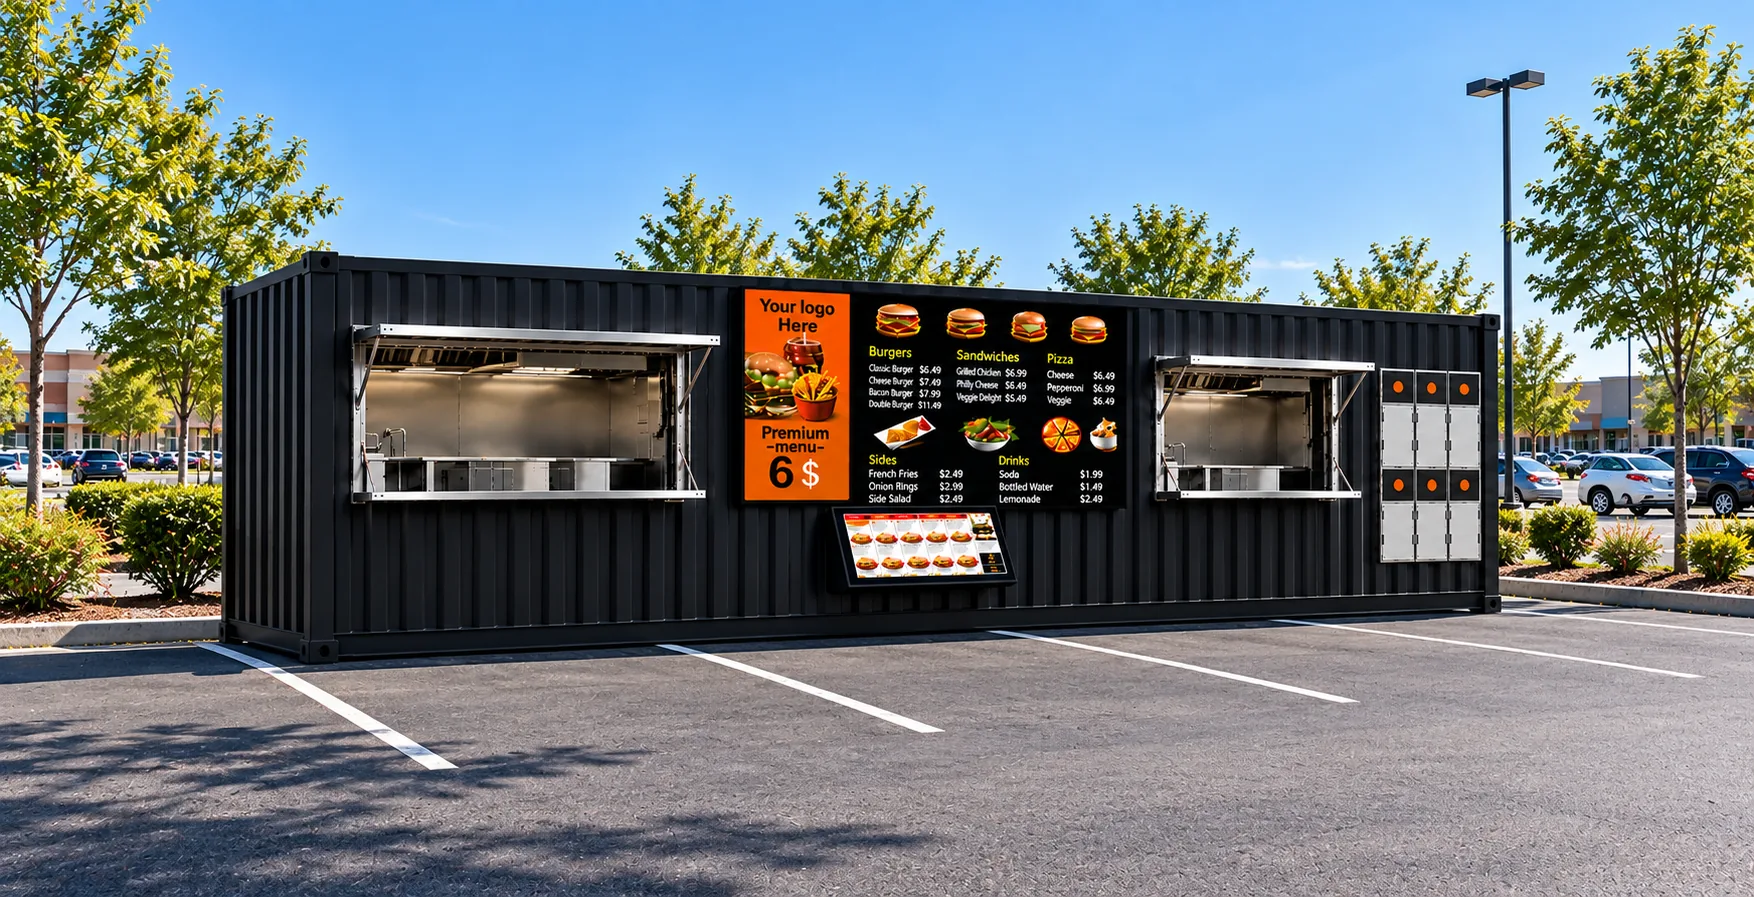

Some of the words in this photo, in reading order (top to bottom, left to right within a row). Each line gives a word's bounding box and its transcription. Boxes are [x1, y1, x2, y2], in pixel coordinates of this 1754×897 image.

[760, 298, 797, 314] Your
[800, 299, 835, 318] logo
[778, 318, 818, 333] Here
[869, 345, 912, 360] Burgers
[956, 349, 1020, 362] Sandwiches
[1047, 353, 1074, 364] Pizza
[868, 363, 891, 373] Classic
[892, 364, 914, 375] Burger
[919, 365, 942, 374] $6.49
[956, 366, 976, 376] Grilled
[1005, 368, 1027, 377] $6.99
[1046, 369, 1075, 379] Cheese
[1093, 370, 1115, 380] $6.49
[868, 375, 891, 385] Cheese
[892, 376, 914, 388] Burger
[919, 377, 942, 386] $7.49
[956, 379, 974, 391] Philly
[975, 380, 999, 389] Cheese
[1046, 382, 1084, 393] Pepperoni
[1093, 383, 1115, 393] $6.99
[868, 387, 890, 396] Bacon
[890, 388, 913, 400] Burger
[918, 389, 941, 398] $7.99
[956, 392, 978, 403] Veggie
[979, 393, 1002, 404] Delight
[1004, 393, 1027, 403] $5.49
[868, 399, 891, 408] Double
[892, 400, 914, 411] Burger
[917, 400, 942, 409] $11.49
[1046, 395, 1072, 406] Veggie
[1093, 396, 1115, 406] $6.49
[761, 425, 830, 440] Premium
[868, 454, 897, 465] Sides
[998, 455, 1030, 466] Drinks
[769, 455, 794, 489] 6
[801, 458, 820, 490] $
[868, 468, 897, 479] French
[898, 468, 919, 479] Fries
[939, 469, 964, 479] $2.49
[998, 469, 1020, 479] Soda
[1080, 469, 1103, 479] $1.99
[868, 481, 894, 491] Onion
[895, 481, 919, 493] Rings
[939, 481, 964, 491] $2.99
[998, 482, 1028, 491] Bottled
[1029, 482, 1054, 491] Water
[1080, 482, 1103, 491] $1.49
[868, 494, 887, 503] Side
[888, 493, 912, 503] Salad
[939, 494, 964, 504] $2.49
[998, 494, 1041, 503] Lemonade
[1080, 494, 1103, 504] $2.49
